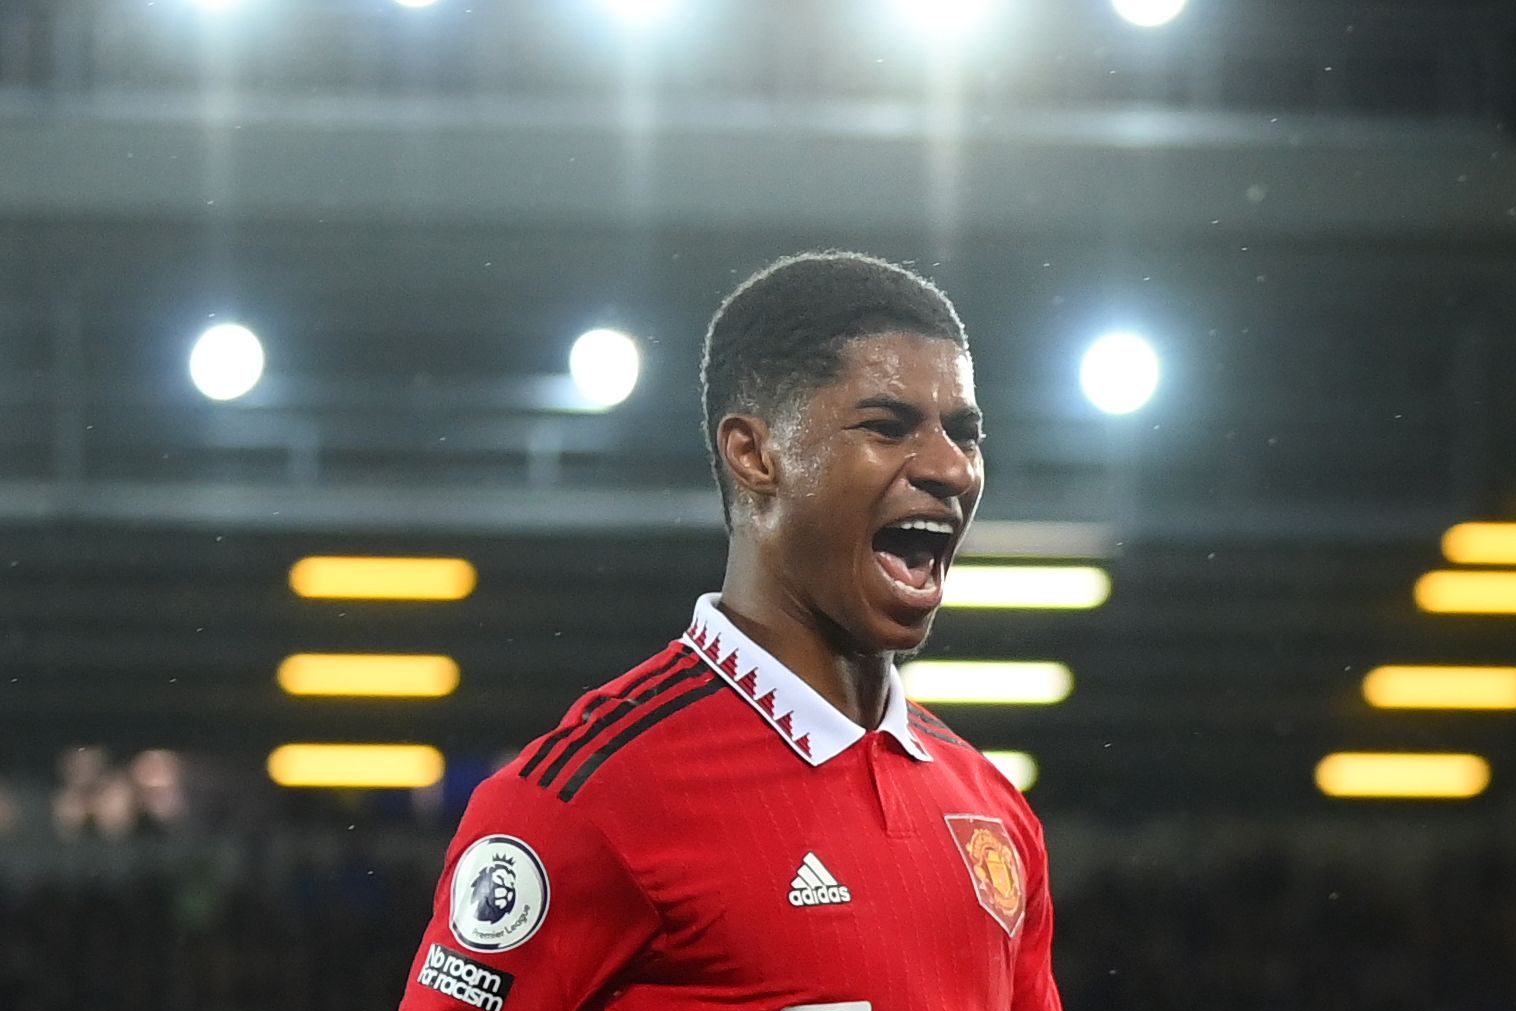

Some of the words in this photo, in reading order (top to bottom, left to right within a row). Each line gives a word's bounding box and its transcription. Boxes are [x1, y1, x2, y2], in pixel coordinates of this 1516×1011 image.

[788, 885, 850, 906] adidas
[472, 927, 504, 939] Premier
[504, 905, 530, 934] League
[425, 944, 445, 969] No
[443, 955, 502, 993] room
